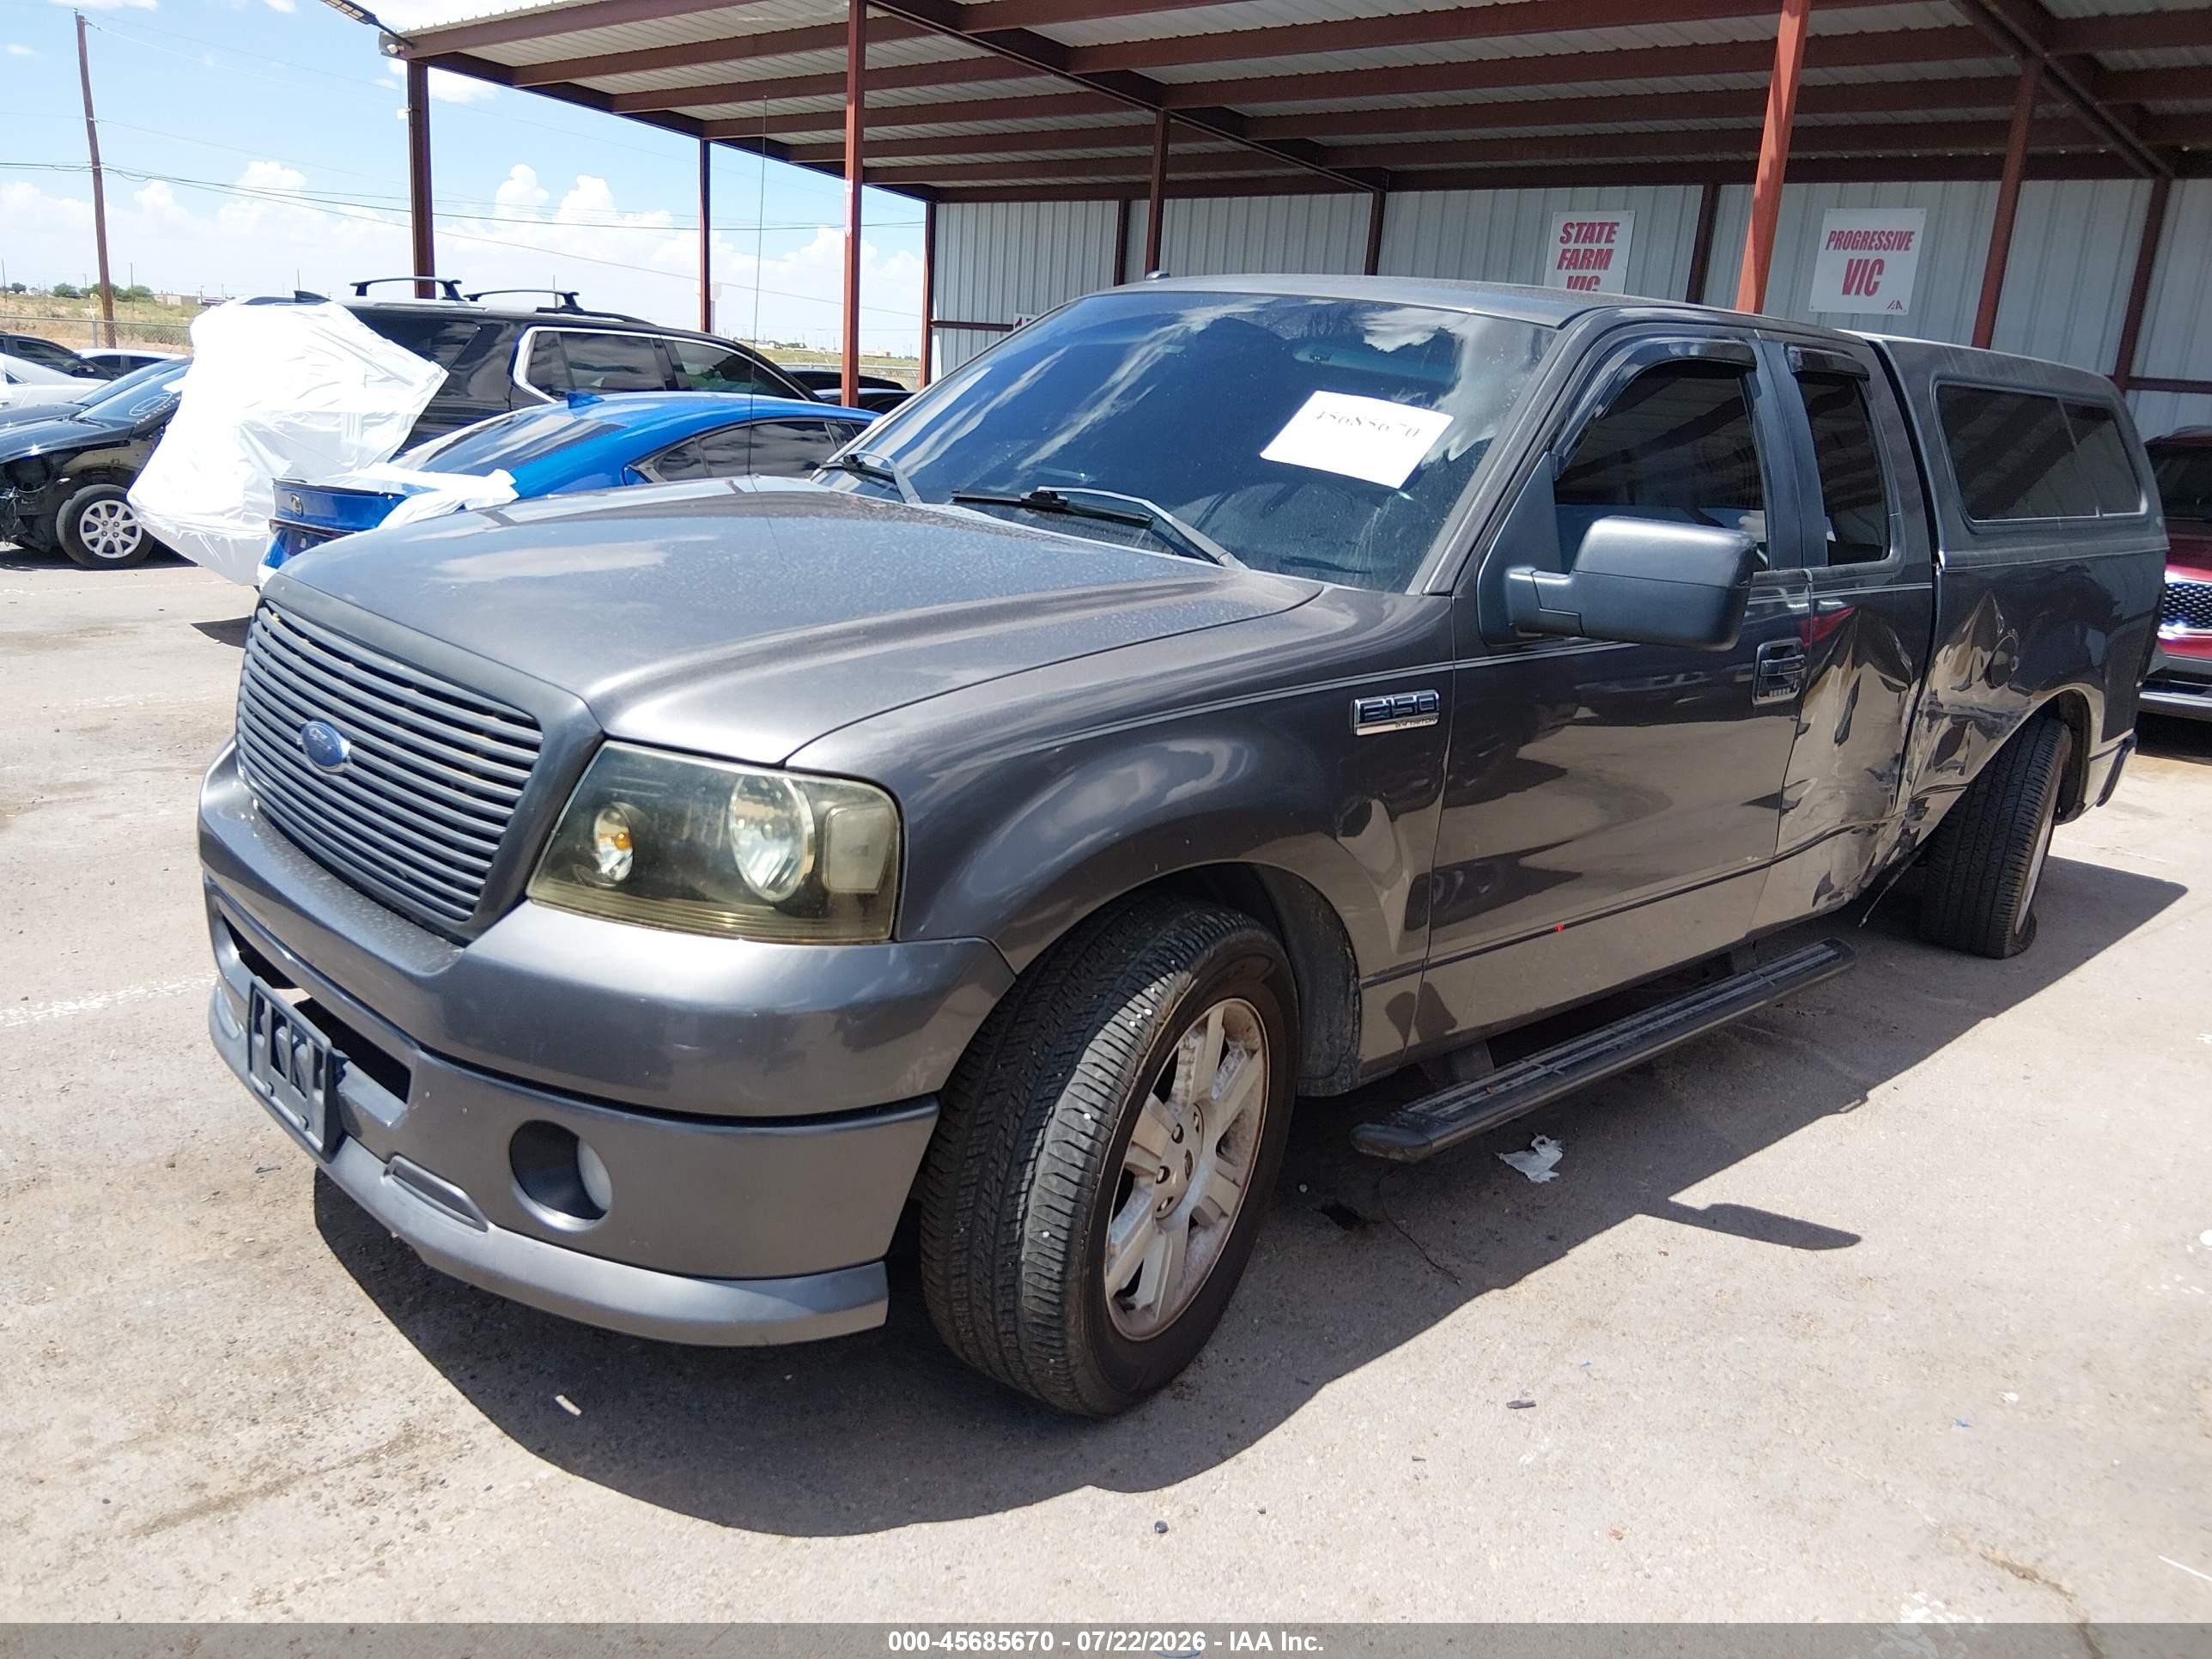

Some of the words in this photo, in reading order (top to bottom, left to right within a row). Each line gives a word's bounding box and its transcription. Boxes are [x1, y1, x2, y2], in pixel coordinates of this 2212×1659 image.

[1559, 222, 1620, 245] STATE
[1826, 230, 1916, 252] PROGRESSIVE
[1556, 248, 1614, 270] FARM
[1841, 258, 1885, 296] VIC
